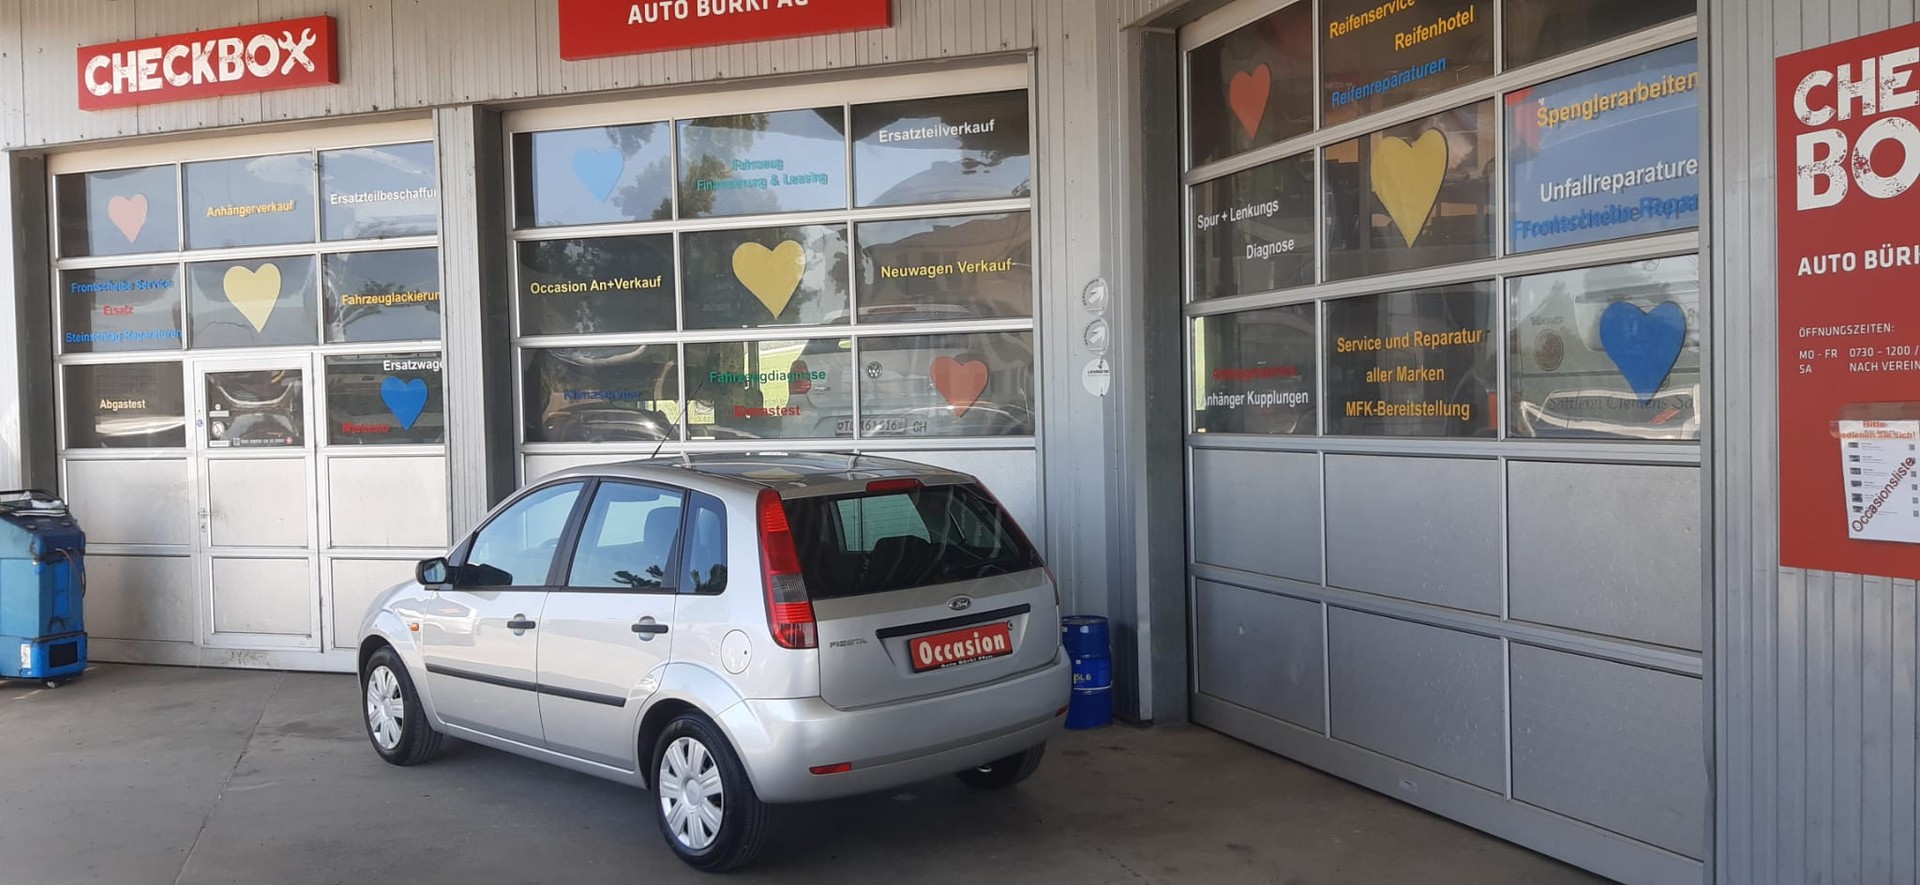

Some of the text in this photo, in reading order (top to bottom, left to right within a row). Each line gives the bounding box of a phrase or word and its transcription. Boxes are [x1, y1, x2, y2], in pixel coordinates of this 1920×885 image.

[628, 0, 689, 25] AUTO
[1395, 5, 1475, 51] Reifenhotel
[85, 28, 317, 97] CHECKBOX
[1331, 57, 1447, 108] Reifenreparaturen
[1537, 71, 1699, 128] Spenglerarbeiten
[879, 118, 996, 143] Ersatzteilverkauf
[1796, 116, 1920, 211] BO
[1540, 157, 1698, 203] Unfallreparature
[207, 200, 295, 218] Anhängerverkauf
[1197, 200, 1280, 231] Spur + Lenkungs
[1246, 239, 1295, 260] Diagnose
[881, 257, 1012, 279] Neuwagen Verkauf
[1797, 251, 1857, 277] AUTO
[530, 275, 662, 294] Occasion An+Verkauf
[1336, 328, 1483, 353] Service und Reparatur
[1798, 322, 1895, 338] ÖFFNUNGSZEITEN:
[1799, 350, 1815, 360] MO
[1825, 348, 1838, 359] FR
[1849, 347, 1875, 358] 0730
[1886, 345, 1911, 356] 1200
[709, 370, 826, 384] Fahrzeugdiagnose
[1366, 364, 1445, 383] aller Marken
[1799, 364, 1813, 374] SA
[1849, 362, 1878, 372] NACH
[100, 399, 146, 412] Abgastest
[1202, 390, 1309, 410] Anhänger Kupplungen
[1346, 400, 1470, 421] MFK-Bereitstellung
[1851, 457, 1914, 533] Occasionsliste
[829, 638, 867, 648] FIESTA
[918, 631, 1006, 665] Occasion
